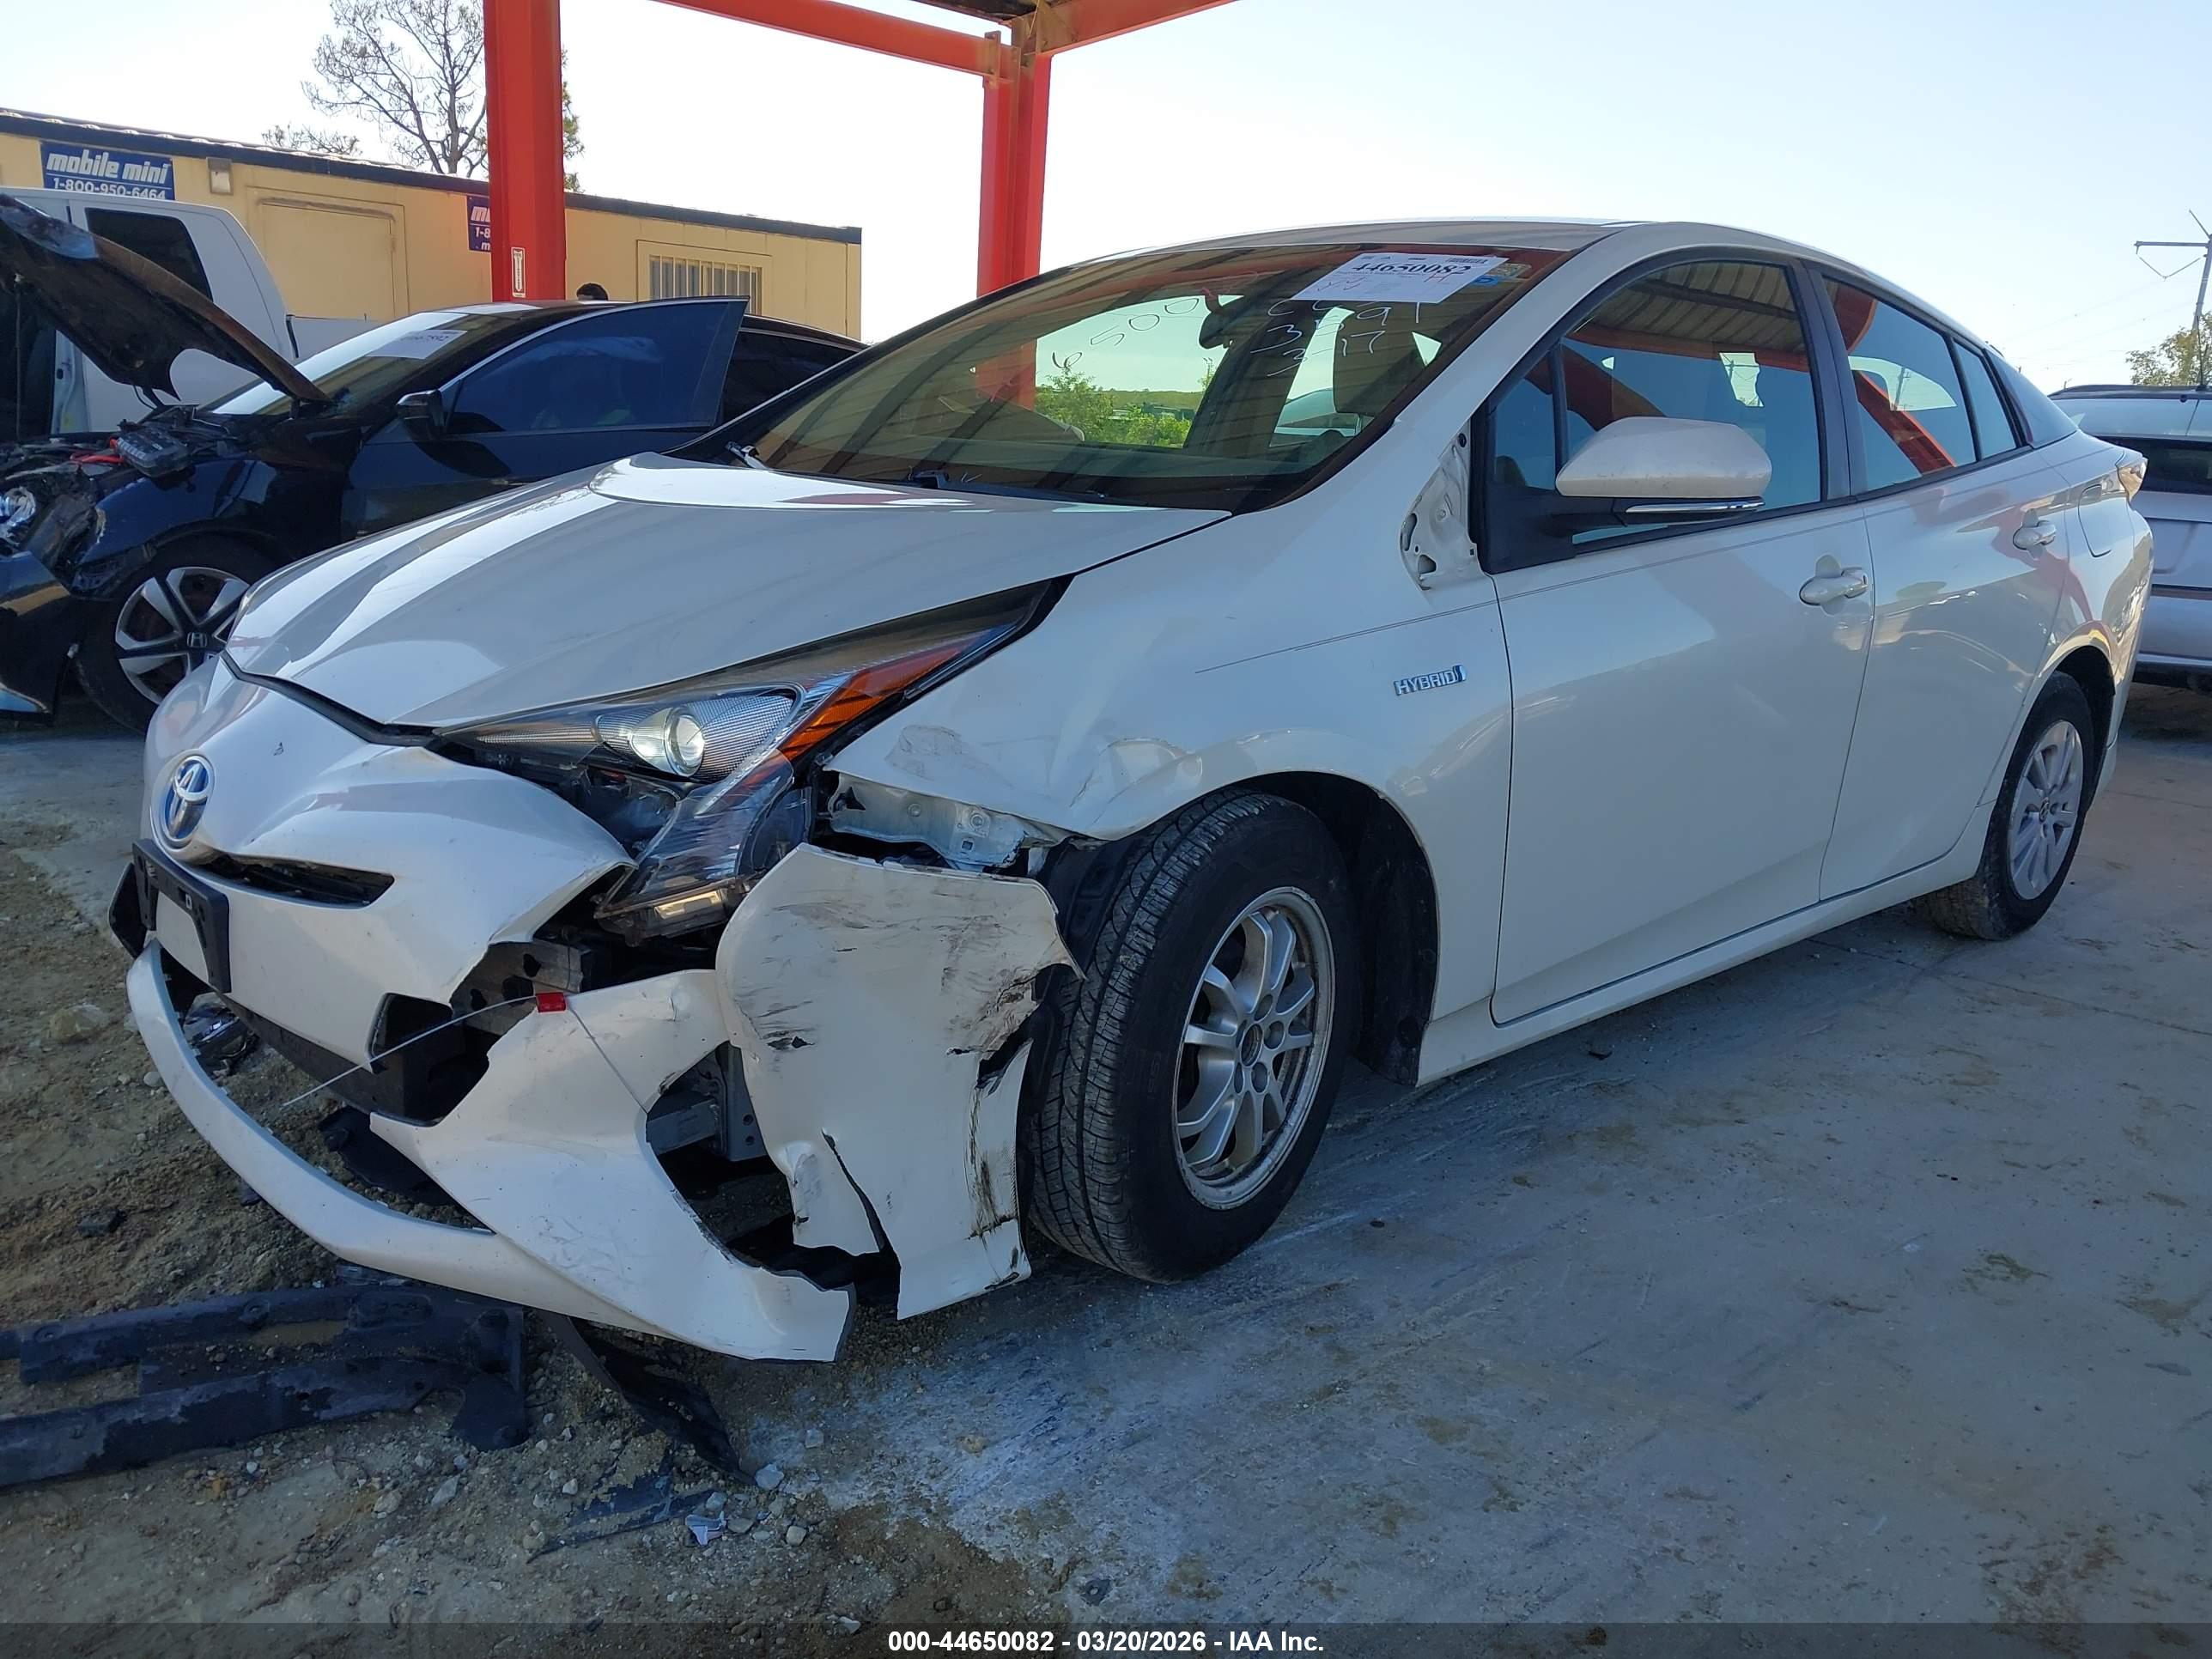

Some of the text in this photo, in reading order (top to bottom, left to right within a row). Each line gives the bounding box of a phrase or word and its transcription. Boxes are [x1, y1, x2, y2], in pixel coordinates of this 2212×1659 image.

[46, 149, 171, 184] mobile mini
[53, 178, 167, 200] 1-800-950-6464
[1352, 261, 1472, 275] 44650082
[1394, 670, 1458, 695] HYBRID
